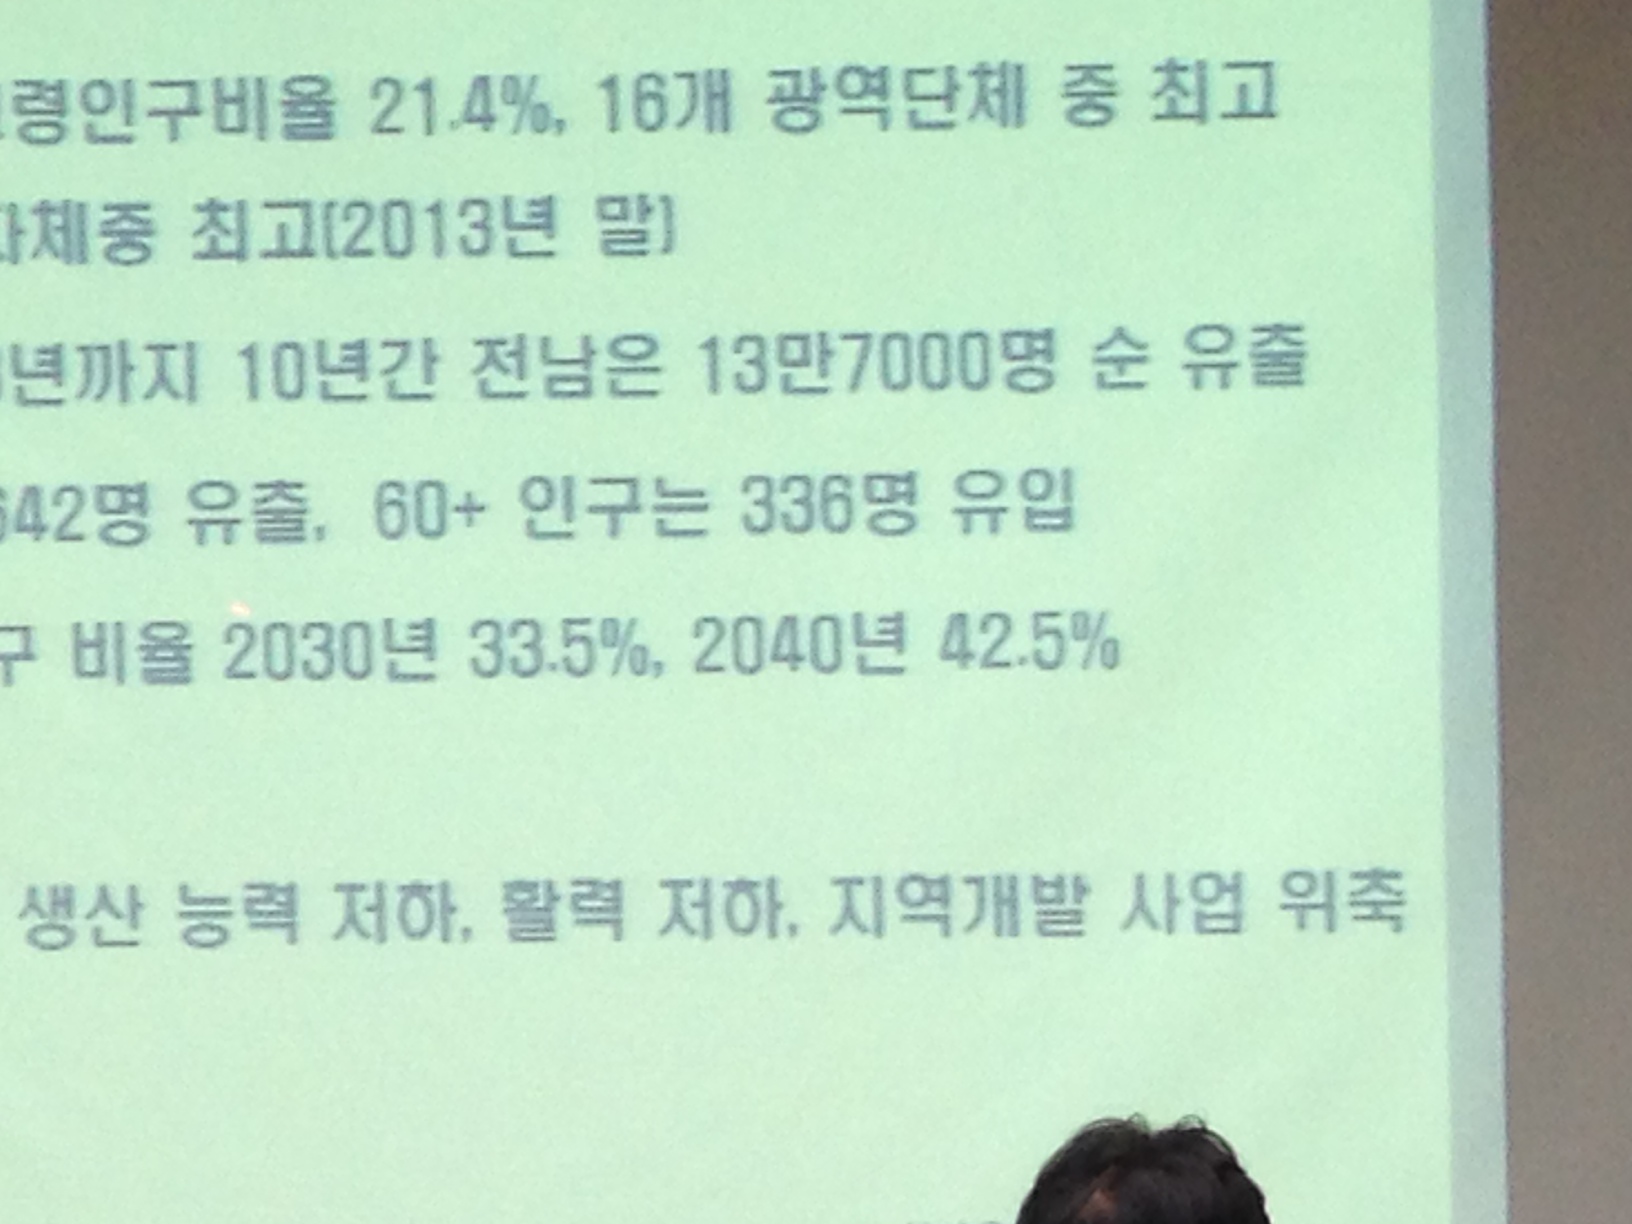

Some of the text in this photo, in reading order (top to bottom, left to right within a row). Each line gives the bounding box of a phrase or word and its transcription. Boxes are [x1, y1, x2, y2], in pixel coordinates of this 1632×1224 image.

[0, 74, 339, 147] 령인구비율
[597, 67, 734, 135] 16개
[765, 59, 1030, 136] 광역단체
[1060, 63, 1122, 130] 중
[1150, 56, 1280, 126] 최고
[0, 322, 1310, 408] 년까지 10년간 전남은 13만7000명 순 유출
[0, 480, 152, 548] 42명
[373, 479, 489, 541] 60+
[518, 474, 711, 541] 인구는
[740, 469, 920, 537] 336명
[951, 466, 1077, 536] 유입
[71, 620, 196, 686] 비율
[223, 617, 438, 684] 2030년
[469, 617, 666, 680] 33.5%,
[692, 610, 909, 677] 2040년
[938, 610, 1121, 671] 42.5%
[17, 883, 146, 952] 생산
[177, 881, 300, 950] 능력
[501, 877, 625, 944] 활력
[829, 872, 1093, 940] 지역개발
[1121, 870, 1245, 936] 사업
[1278, 866, 1408, 935] 위축
